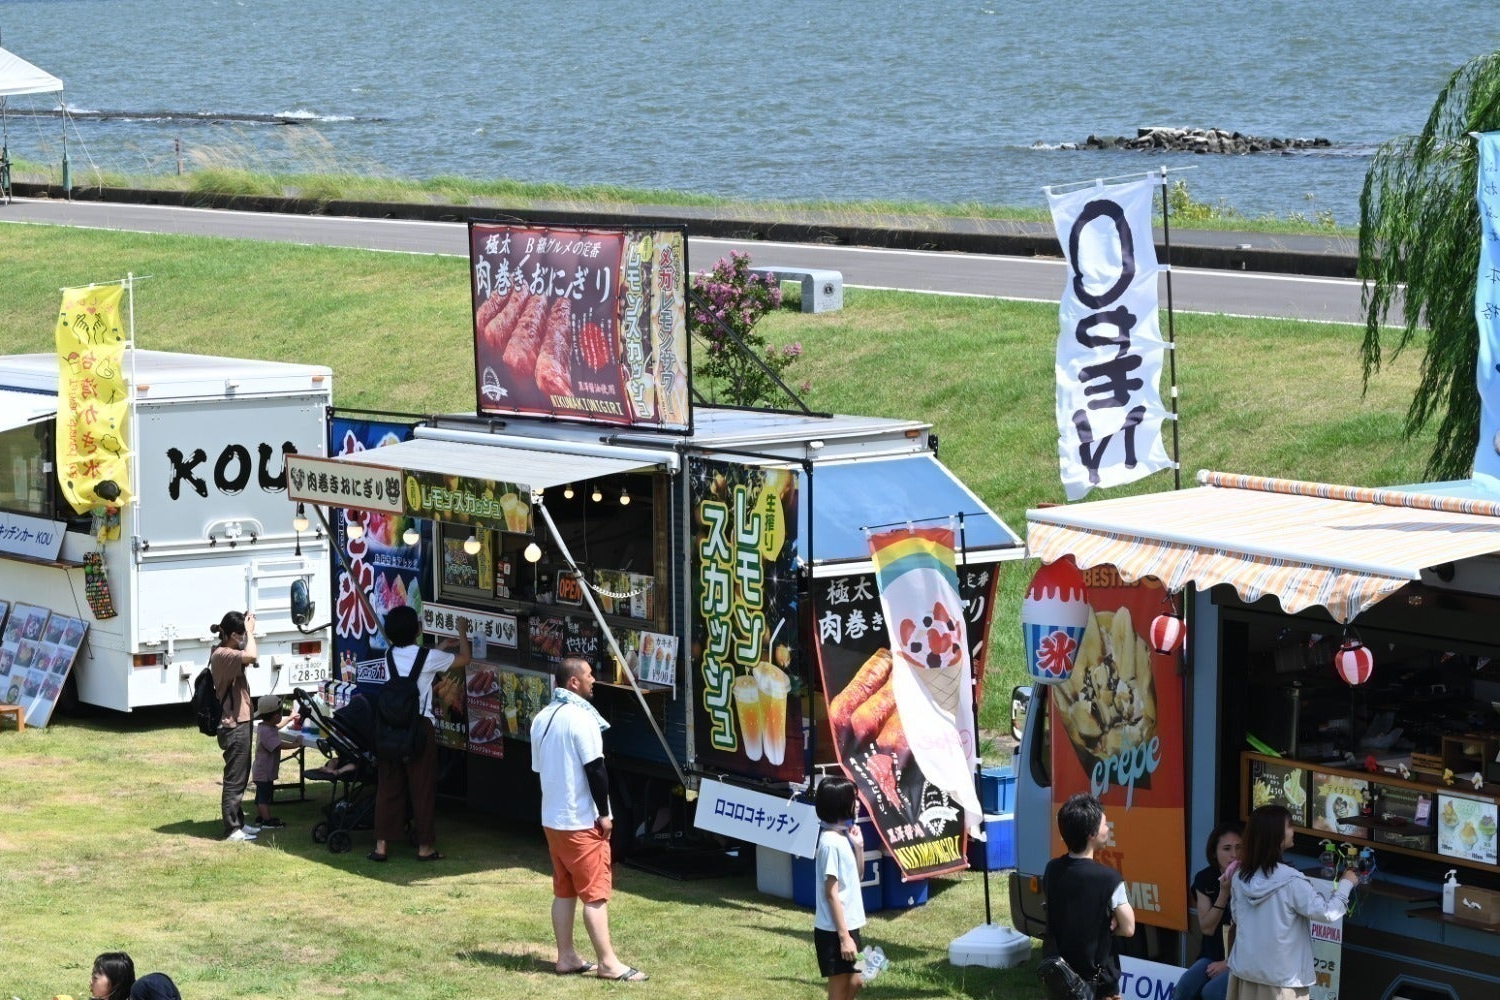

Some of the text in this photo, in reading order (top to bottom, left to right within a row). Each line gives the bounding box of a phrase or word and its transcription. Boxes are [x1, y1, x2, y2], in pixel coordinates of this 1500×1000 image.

[485, 233, 512, 255] 極太
[475, 255, 611, 303] 肉巻きおにぎり
[166, 440, 298, 500] KOU
[307, 472, 384, 500] 肉巻きおにぎり
[421, 485, 502, 518] レモンスカッシュ
[36, 531, 54, 546] KOU
[764, 494, 777, 552] 生搾り
[559, 577, 582, 598] OPEN
[735, 487, 763, 665] レモン
[826, 576, 874, 605] 極太
[702, 502, 737, 750] スカッシュ
[818, 609, 885, 645] 肉巻き
[1036, 631, 1079, 677] 氷
[1091, 728, 1162, 813] crêpe
[714, 798, 800, 835] ロコロコキッチン
[1311, 923, 1342, 942] PIKAPIKA
